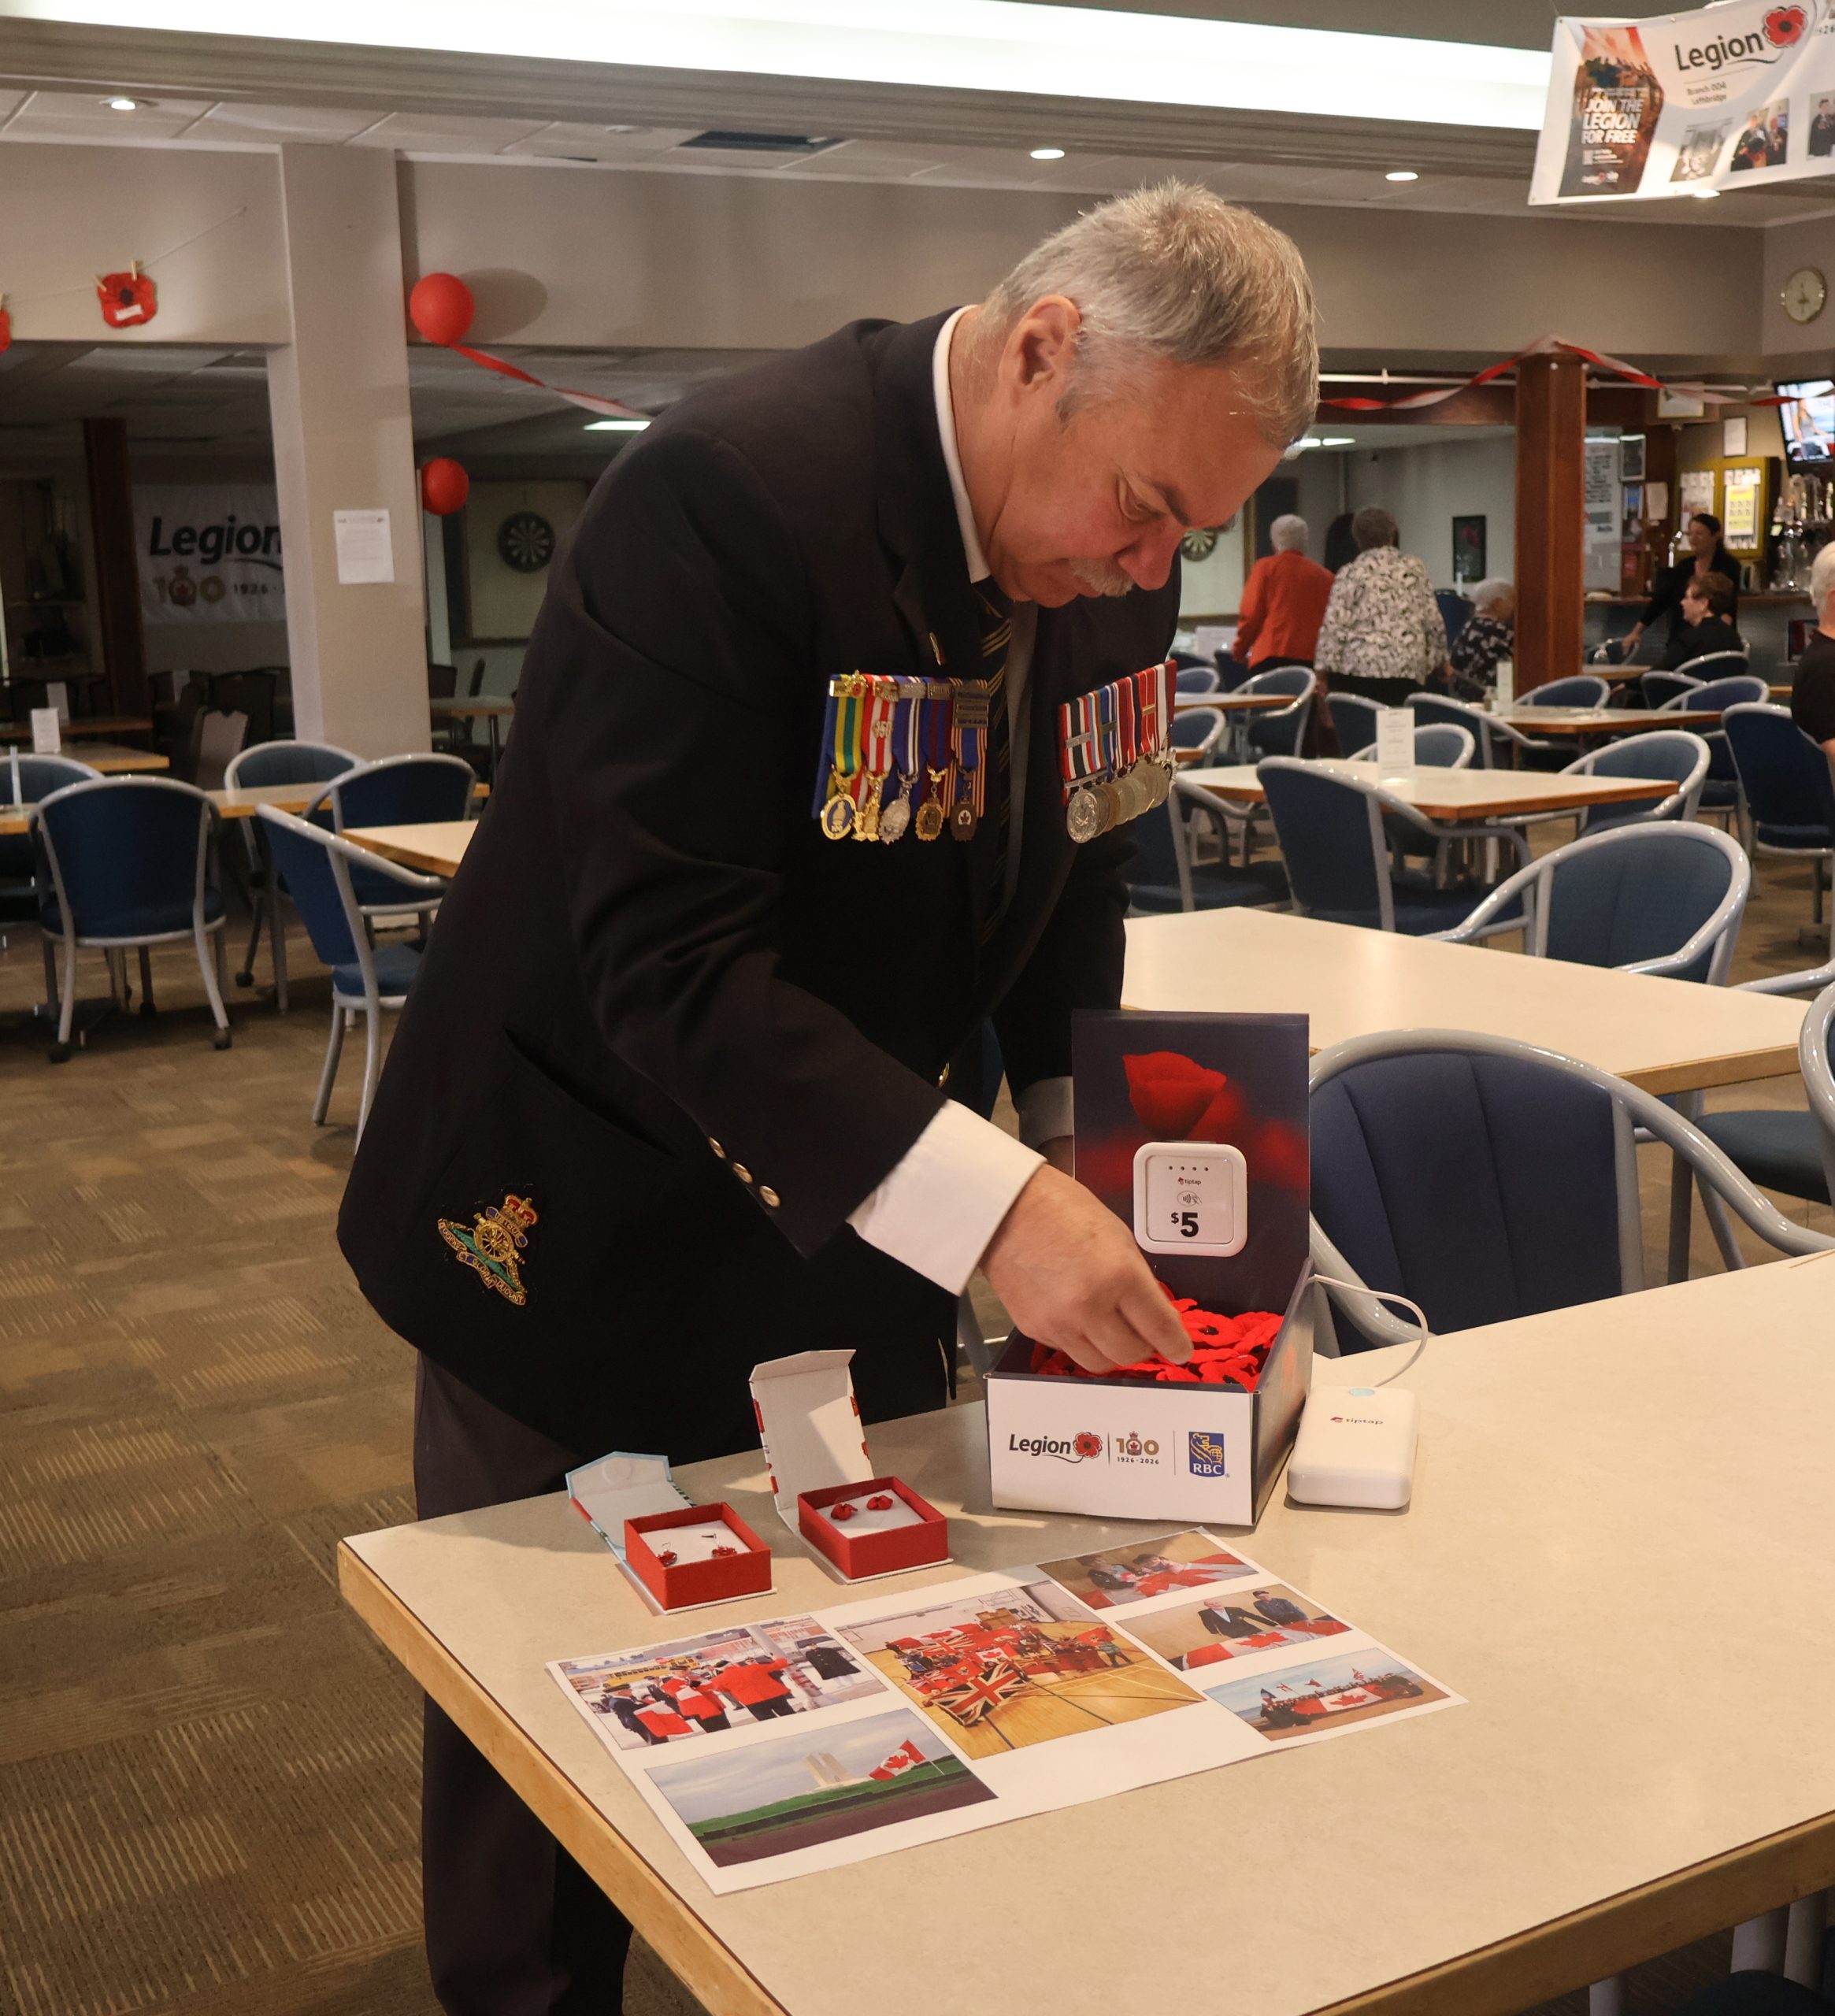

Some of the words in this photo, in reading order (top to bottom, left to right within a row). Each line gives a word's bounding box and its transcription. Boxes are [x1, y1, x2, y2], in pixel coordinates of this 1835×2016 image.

[1674, 32, 1764, 71] Legion
[1585, 98, 1617, 113] JOIN
[1620, 98, 1644, 112] THE
[1582, 113, 1640, 130] LEGION
[1581, 130, 1604, 144] FOR
[1604, 129, 1638, 144] FREE
[150, 514, 282, 565] Legion
[1171, 1212, 1199, 1237] $5
[1009, 1434, 1071, 1456] Legion
[1192, 1462, 1222, 1475] RBC
